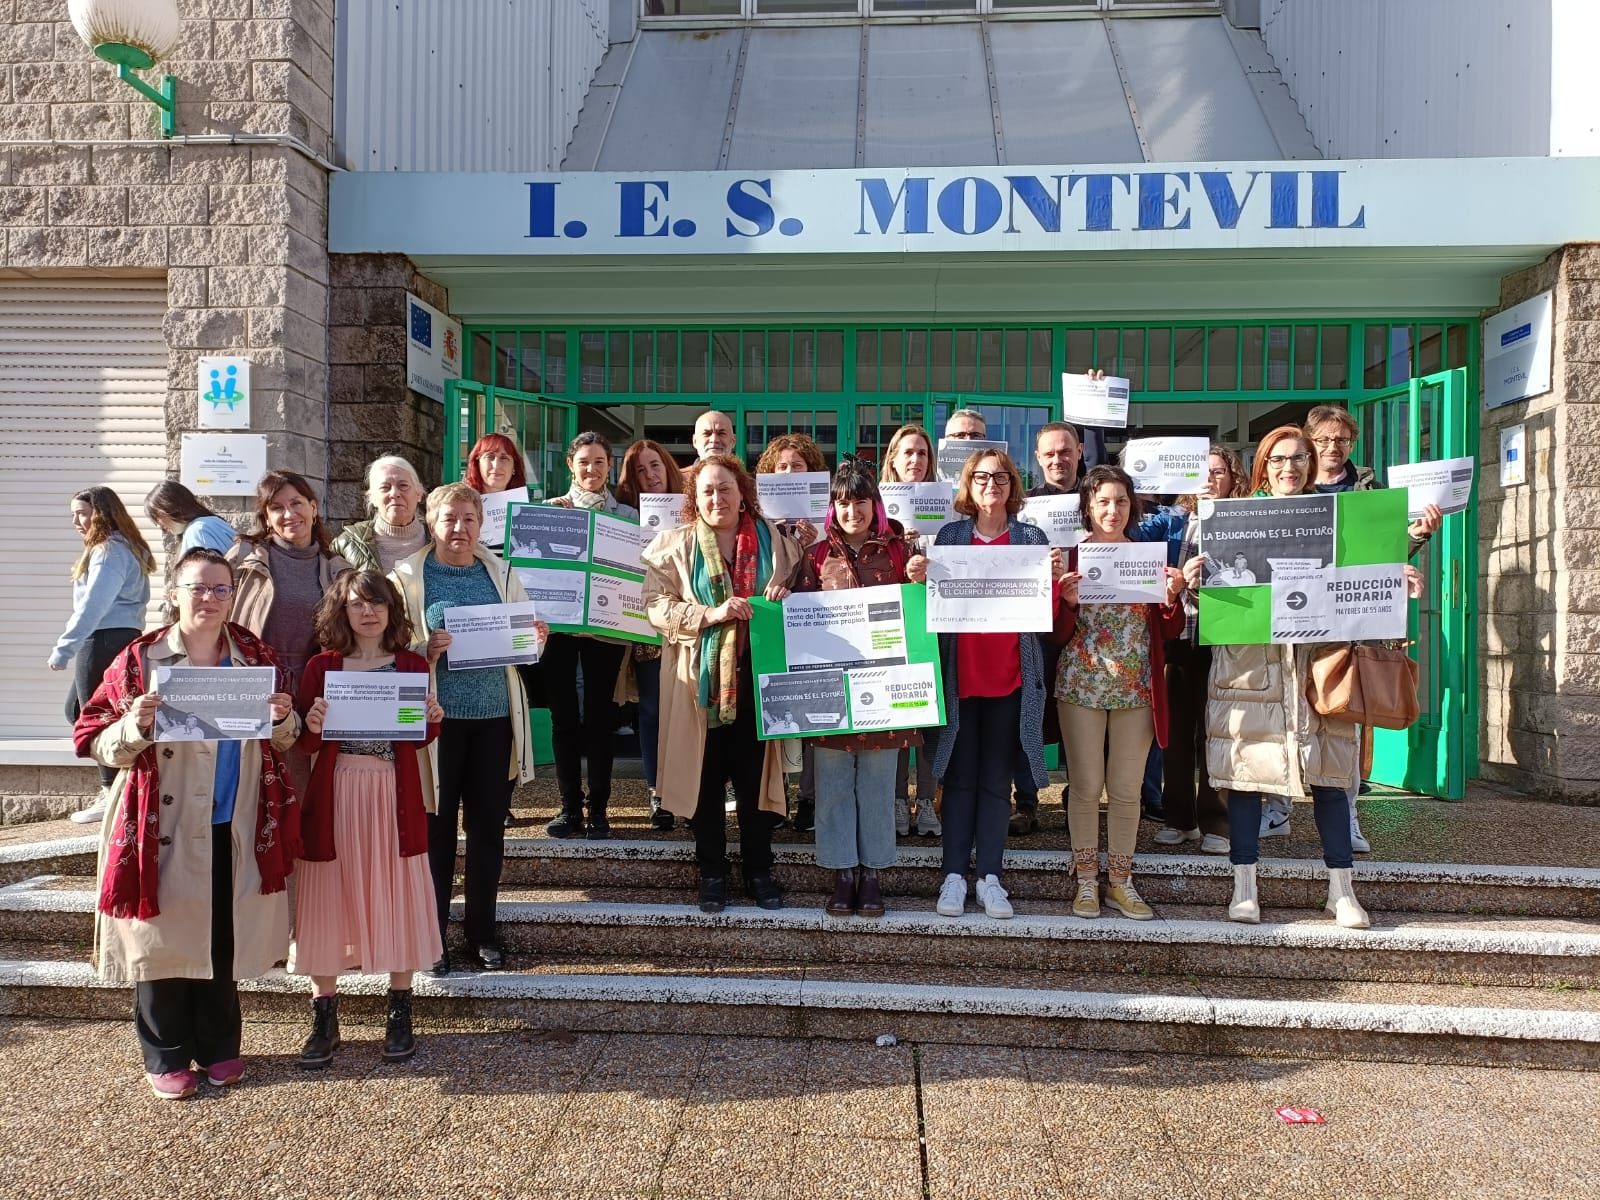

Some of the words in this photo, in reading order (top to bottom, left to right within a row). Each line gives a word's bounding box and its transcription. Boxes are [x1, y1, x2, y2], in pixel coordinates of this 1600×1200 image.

[524, 182, 588, 238] I.
[615, 181, 697, 238] E.
[726, 178, 804, 238] S.
[854, 170, 1365, 234] MONTEVIL
[1159, 454, 1206, 462] REDUCCIÓN
[487, 508, 506, 516] REDU
[566, 526, 588, 534] FUTURO
[1202, 532, 1213, 540] LA
[1216, 529, 1266, 540] EDUCACIÓN
[1268, 529, 1279, 538] ES
[1282, 529, 1293, 537] EL
[1296, 526, 1333, 537] FUTURO
[1114, 560, 1163, 568] REDUCCIÓN
[941, 581, 983, 589] REDUCCIÓN
[1327, 577, 1402, 592] REDUCCIÓN
[944, 588, 952, 596] EL
[953, 588, 983, 596] CUERPO
[984, 588, 994, 596] DE
[1336, 590, 1393, 603] HORARIA
[622, 602, 644, 611] HORAR
[813, 605, 842, 613] permisos
[1336, 607, 1360, 615] MAYORES
[841, 617, 866, 626] propios
[885, 681, 933, 692] REDUCCIÓN
[170, 693, 214, 702] EDUCACIÓN
[217, 693, 226, 701] ES
[228, 693, 237, 701] EL
[240, 692, 272, 701] FUTURO
[771, 694, 803, 702] EDUCACIÓN
[821, 690, 845, 699] FUTURO
[891, 690, 928, 700] HORARIA
